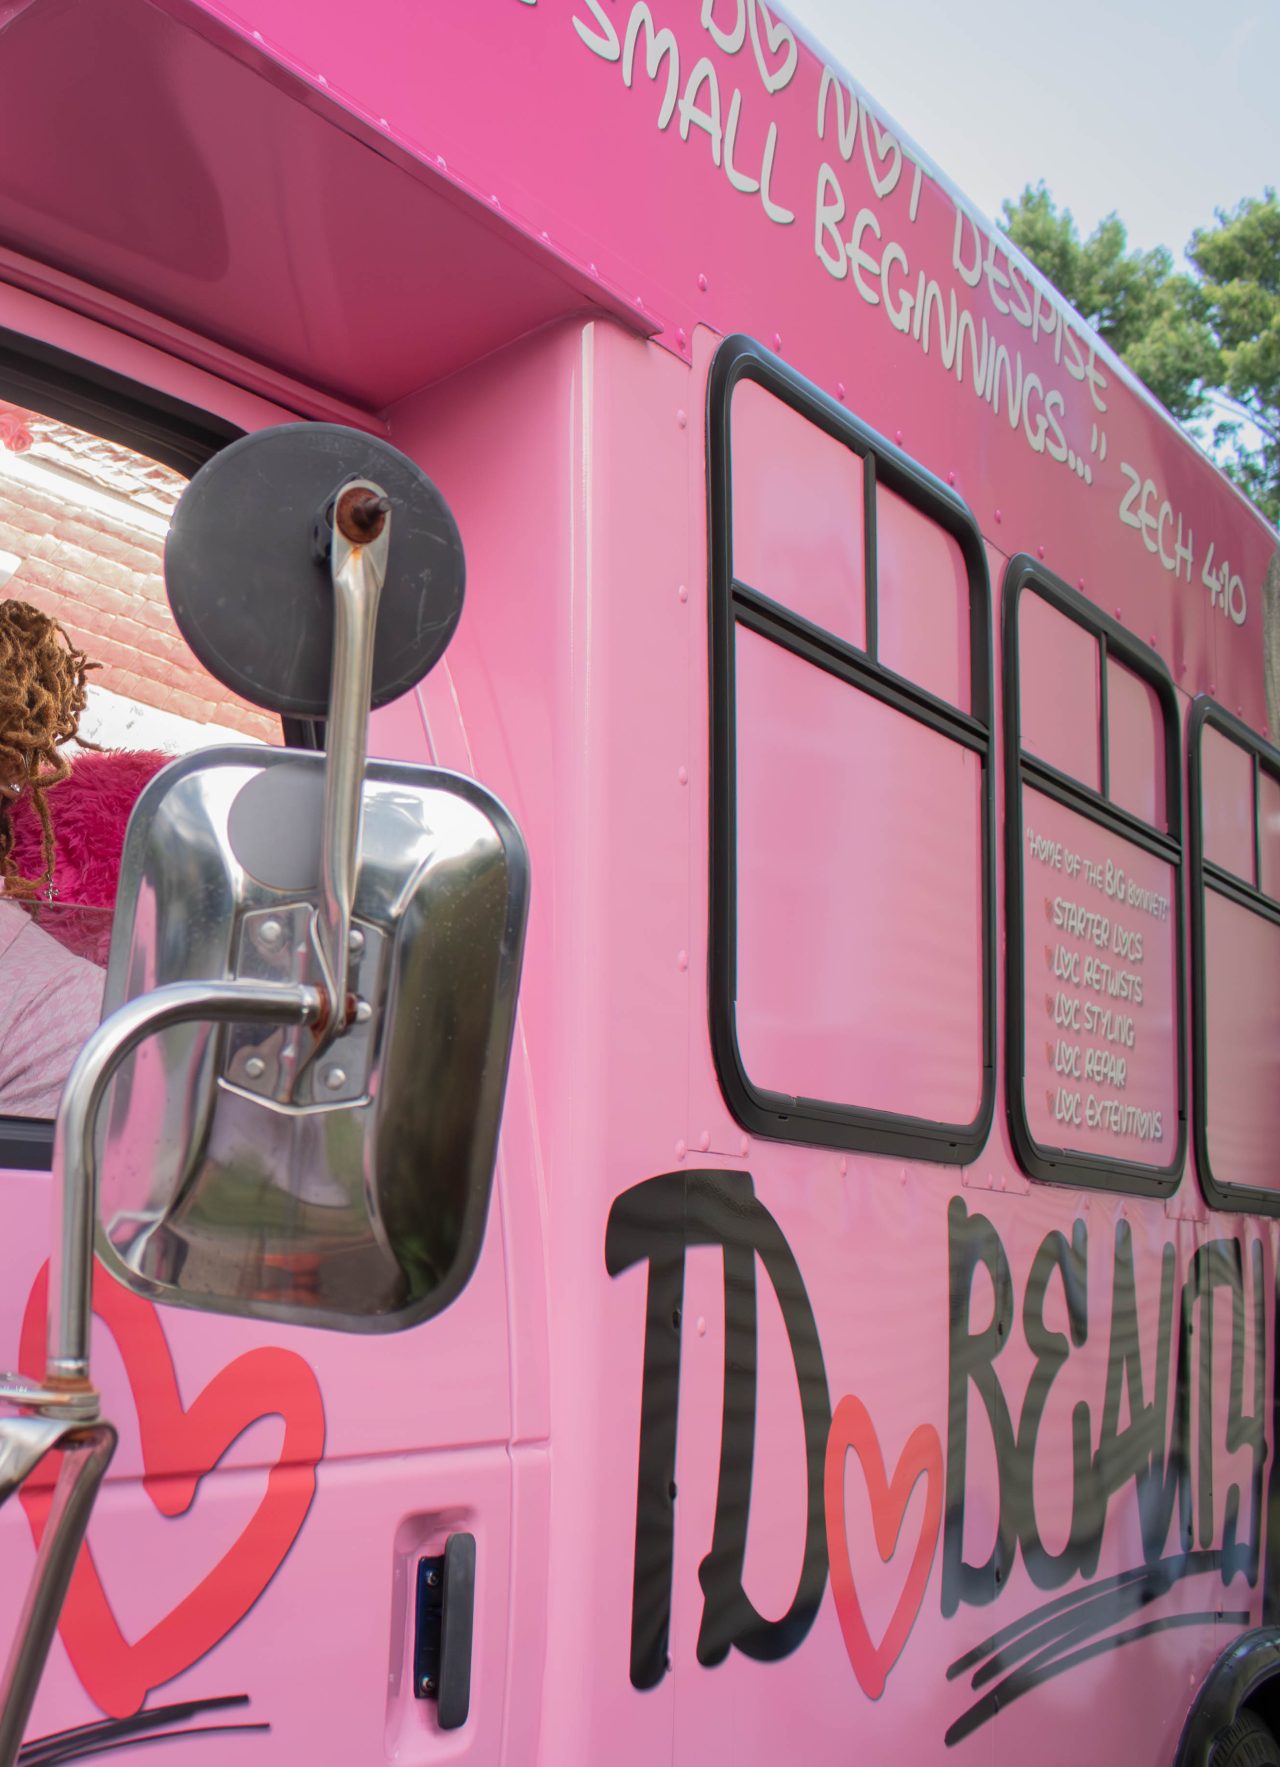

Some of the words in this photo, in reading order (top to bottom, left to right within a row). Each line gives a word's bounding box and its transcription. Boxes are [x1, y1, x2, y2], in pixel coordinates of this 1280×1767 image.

[571, 0, 796, 224] SMALL
[1119, 462, 1194, 583] ZECH
[1083, 860, 1104, 889] THE
[1104, 859, 1126, 900] BIG
[1053, 896, 1110, 948] STARTER
[1113, 923, 1143, 961] LOCS
[1054, 944, 1080, 984] LOC
[1083, 955, 1143, 1003] RETWISTS
[1054, 991, 1081, 1031] LOC
[1083, 1001, 1135, 1047] STYLING
[1054, 1039, 1081, 1077] LOC
[1084, 1047, 1127, 1089] REPAIR
[1055, 1086, 1082, 1125] LOC
